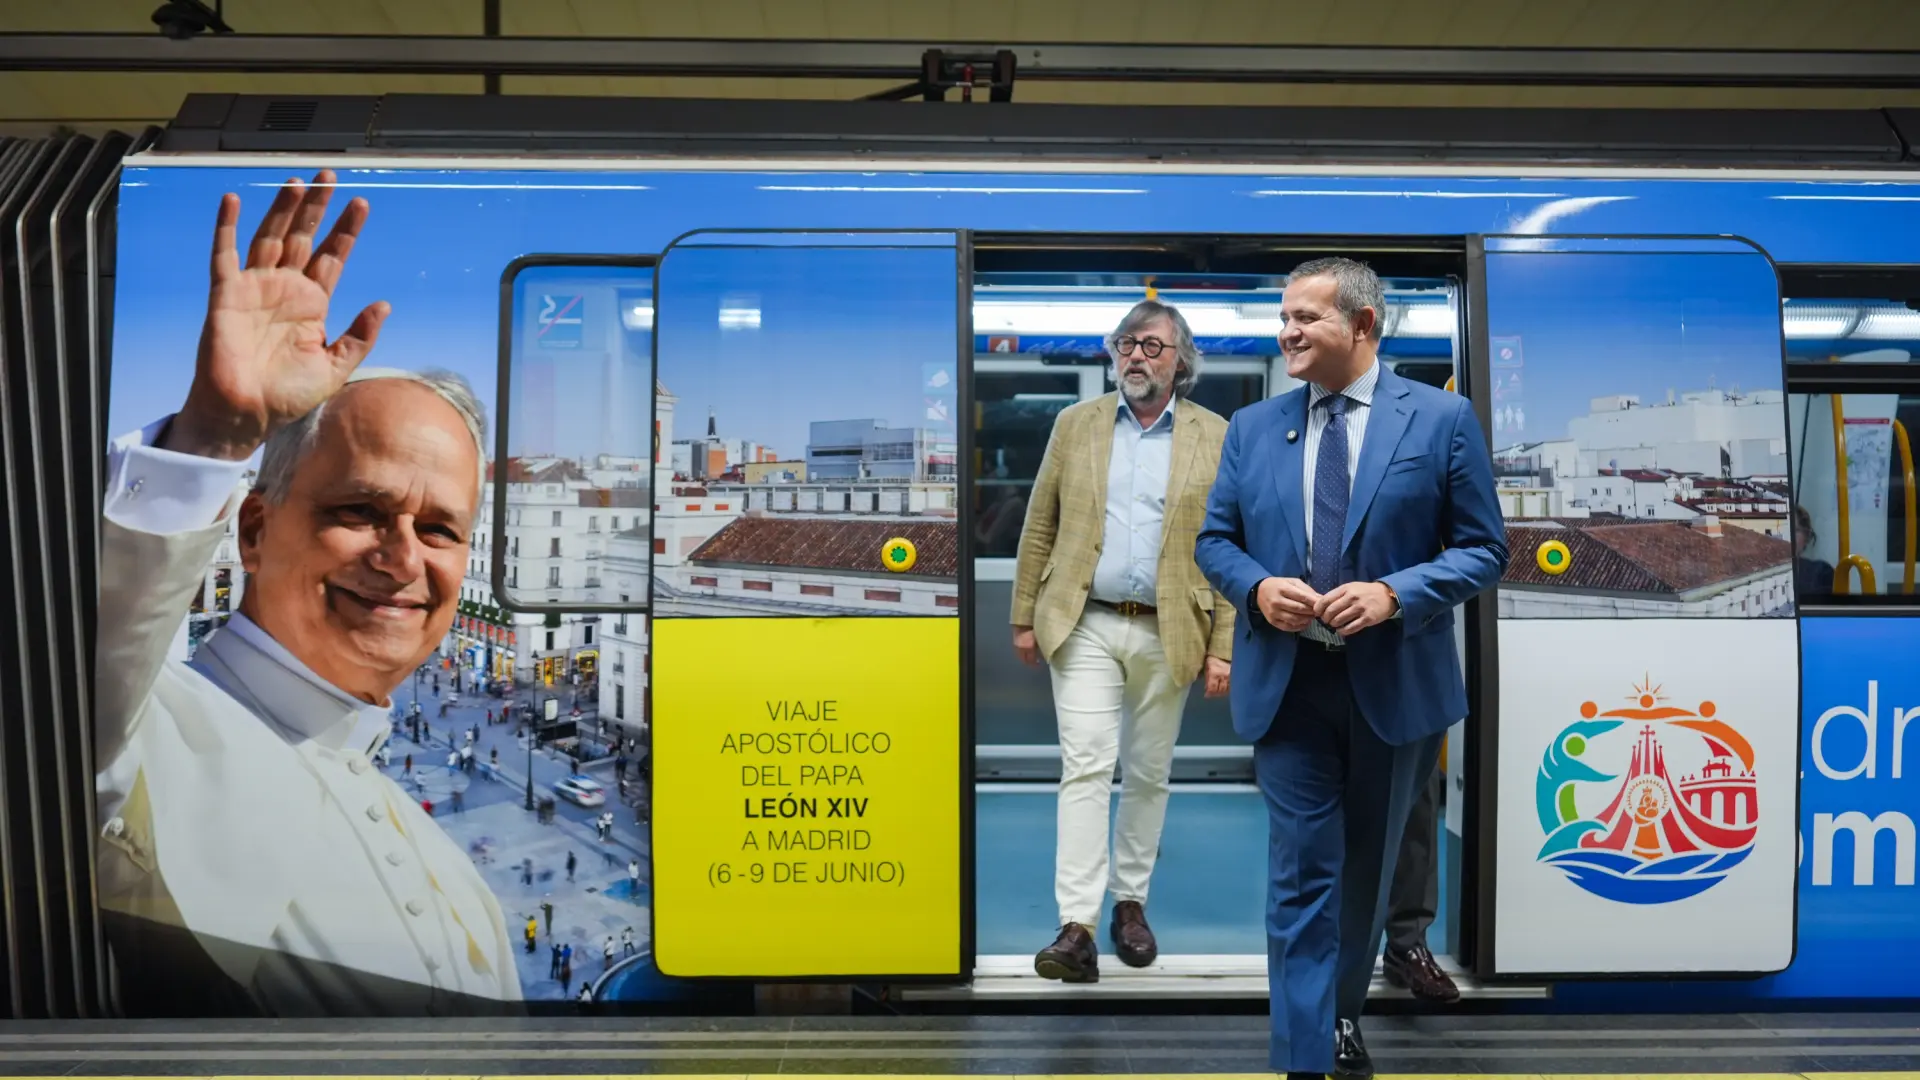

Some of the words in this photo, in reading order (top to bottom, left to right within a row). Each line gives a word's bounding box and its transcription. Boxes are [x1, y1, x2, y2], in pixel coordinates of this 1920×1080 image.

[765, 700, 839, 722] VIAJE
[719, 727, 892, 755] APOSTÓLICO
[1800, 679, 1920, 781] dr
[741, 765, 792, 787] DEL
[799, 764, 865, 786] PAPA
[744, 792, 818, 819] LEÓN
[826, 797, 870, 819] XIV
[740, 830, 760, 851] A
[767, 829, 872, 851] MADRID
[773, 861, 808, 883] DE
[815, 860, 906, 887] JUNIO)
